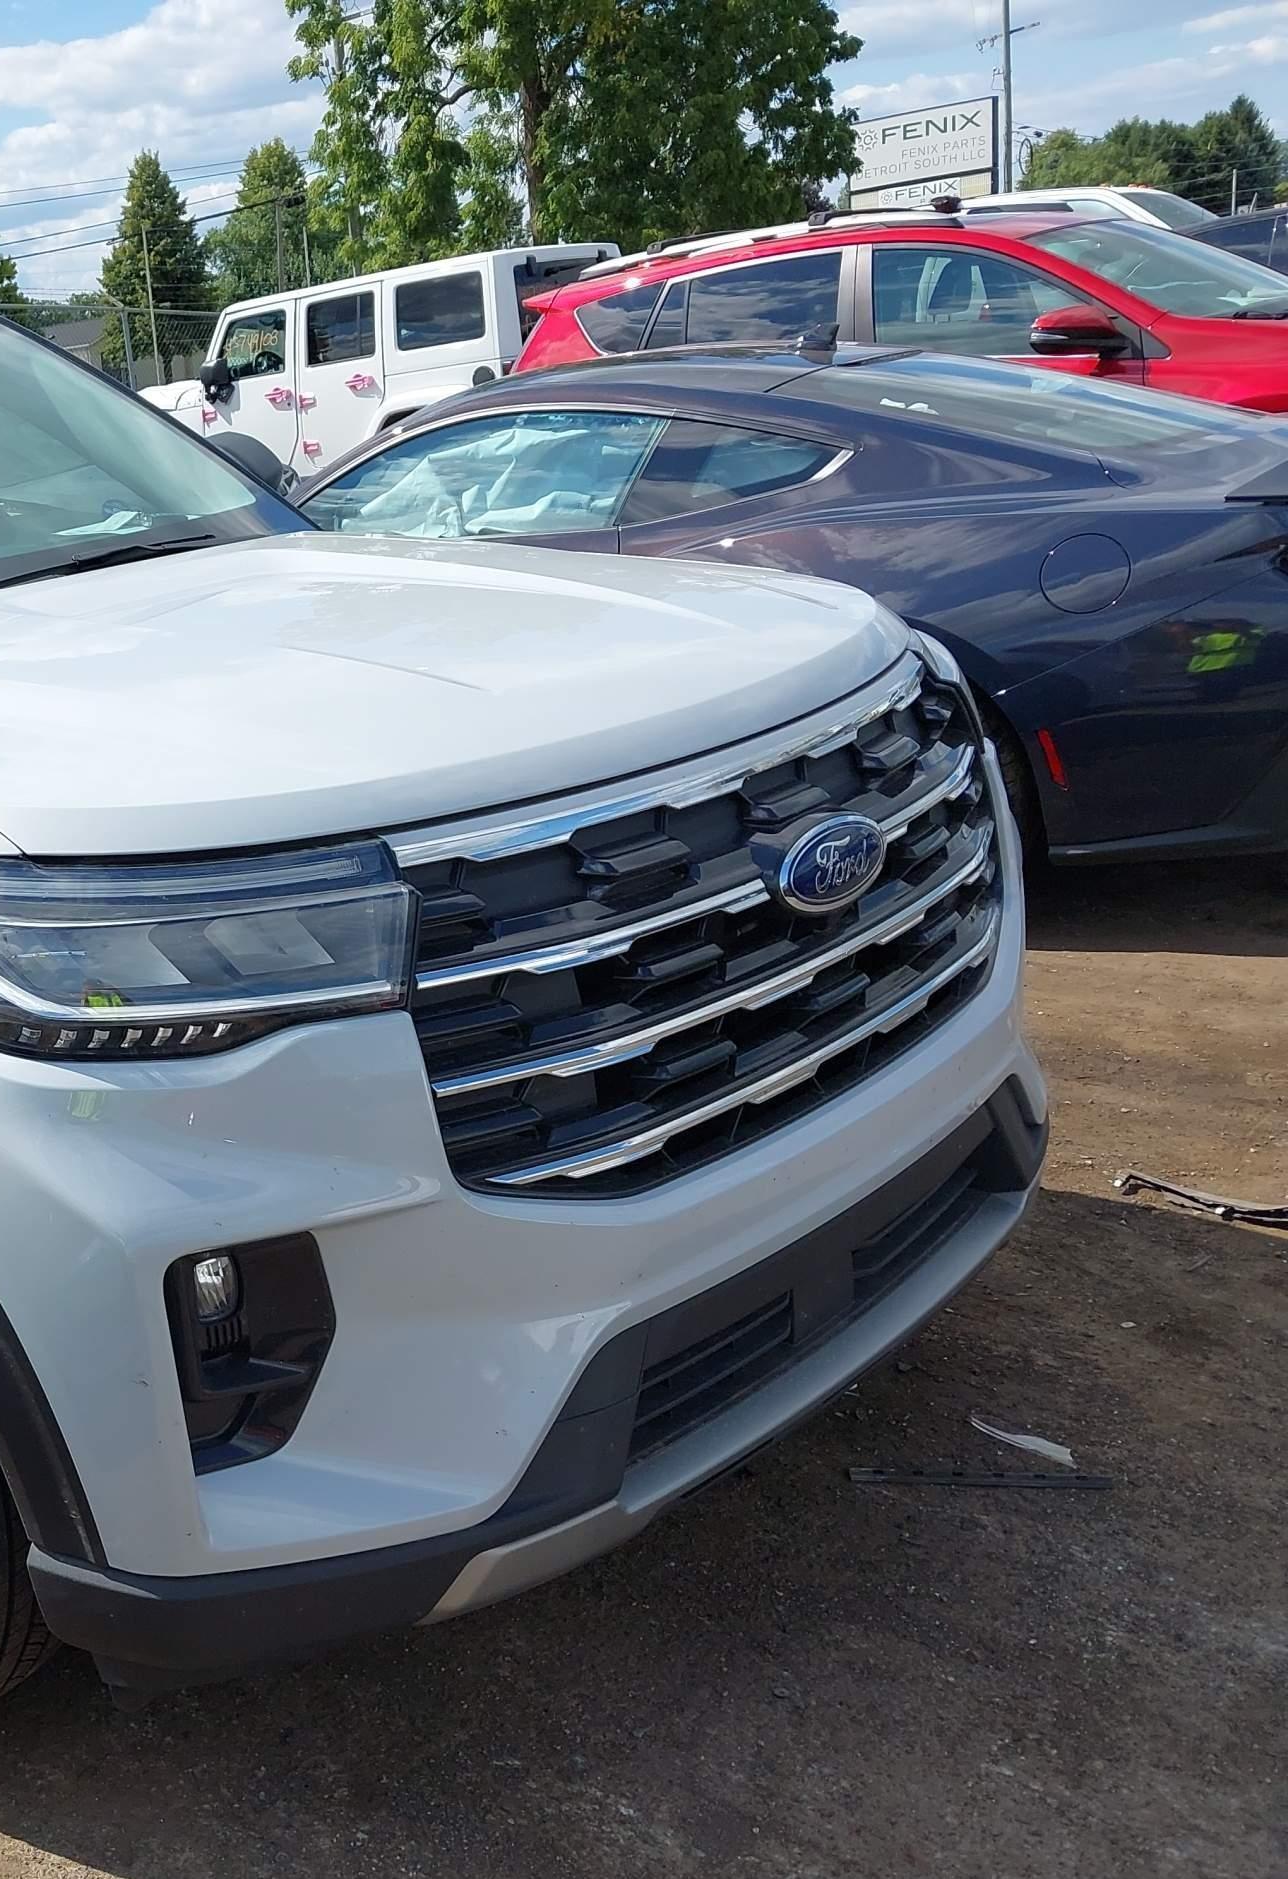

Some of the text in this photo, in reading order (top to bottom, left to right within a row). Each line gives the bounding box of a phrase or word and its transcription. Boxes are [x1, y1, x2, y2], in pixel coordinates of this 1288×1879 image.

[881, 110, 981, 144] FENIX
[901, 135, 986, 159] FENIX PARTS
[914, 153, 957, 170] SOUTH
[963, 148, 985, 162] LLC
[895, 179, 958, 201] FENIX
[815, 835, 870, 894] Ford
